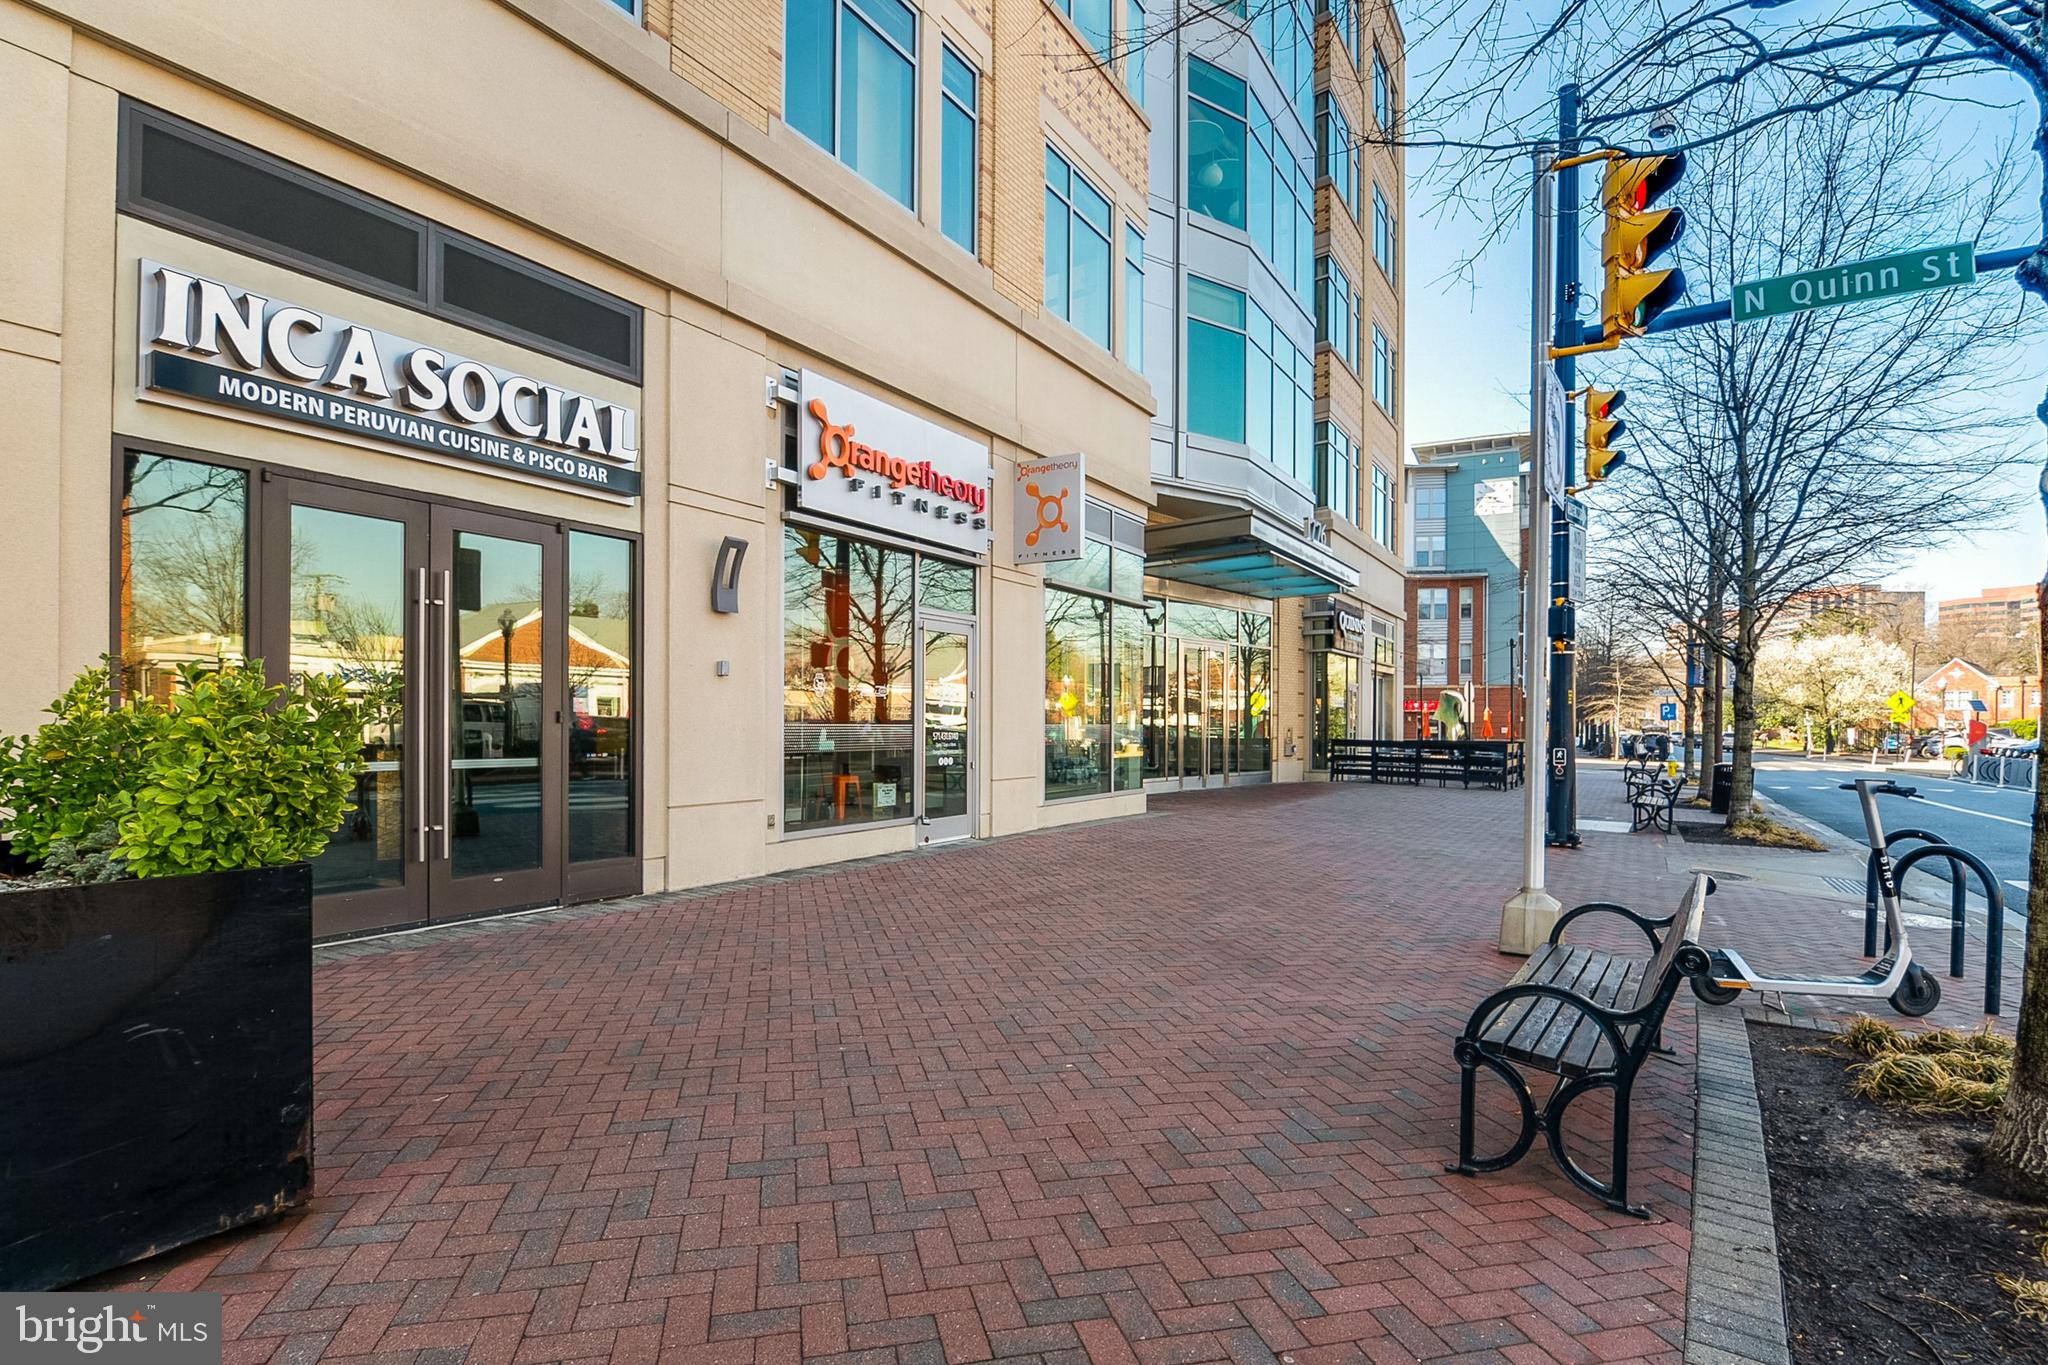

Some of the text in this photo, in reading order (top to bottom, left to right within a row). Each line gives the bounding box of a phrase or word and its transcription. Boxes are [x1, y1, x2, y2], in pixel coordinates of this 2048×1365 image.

[1744, 250, 1961, 313] N Quinn St
[152, 268, 640, 462] INCA SOCIAL
[218, 375, 608, 483] MODERN PERUVIAN CUISINE & PISCO BAR
[808, 398, 986, 513] Orangetheory
[1017, 461, 1078, 481] Orangetheory
[849, 478, 986, 530] FITNESS
[1662, 705, 1670, 716] P
[1880, 855, 1894, 889] BIRD
